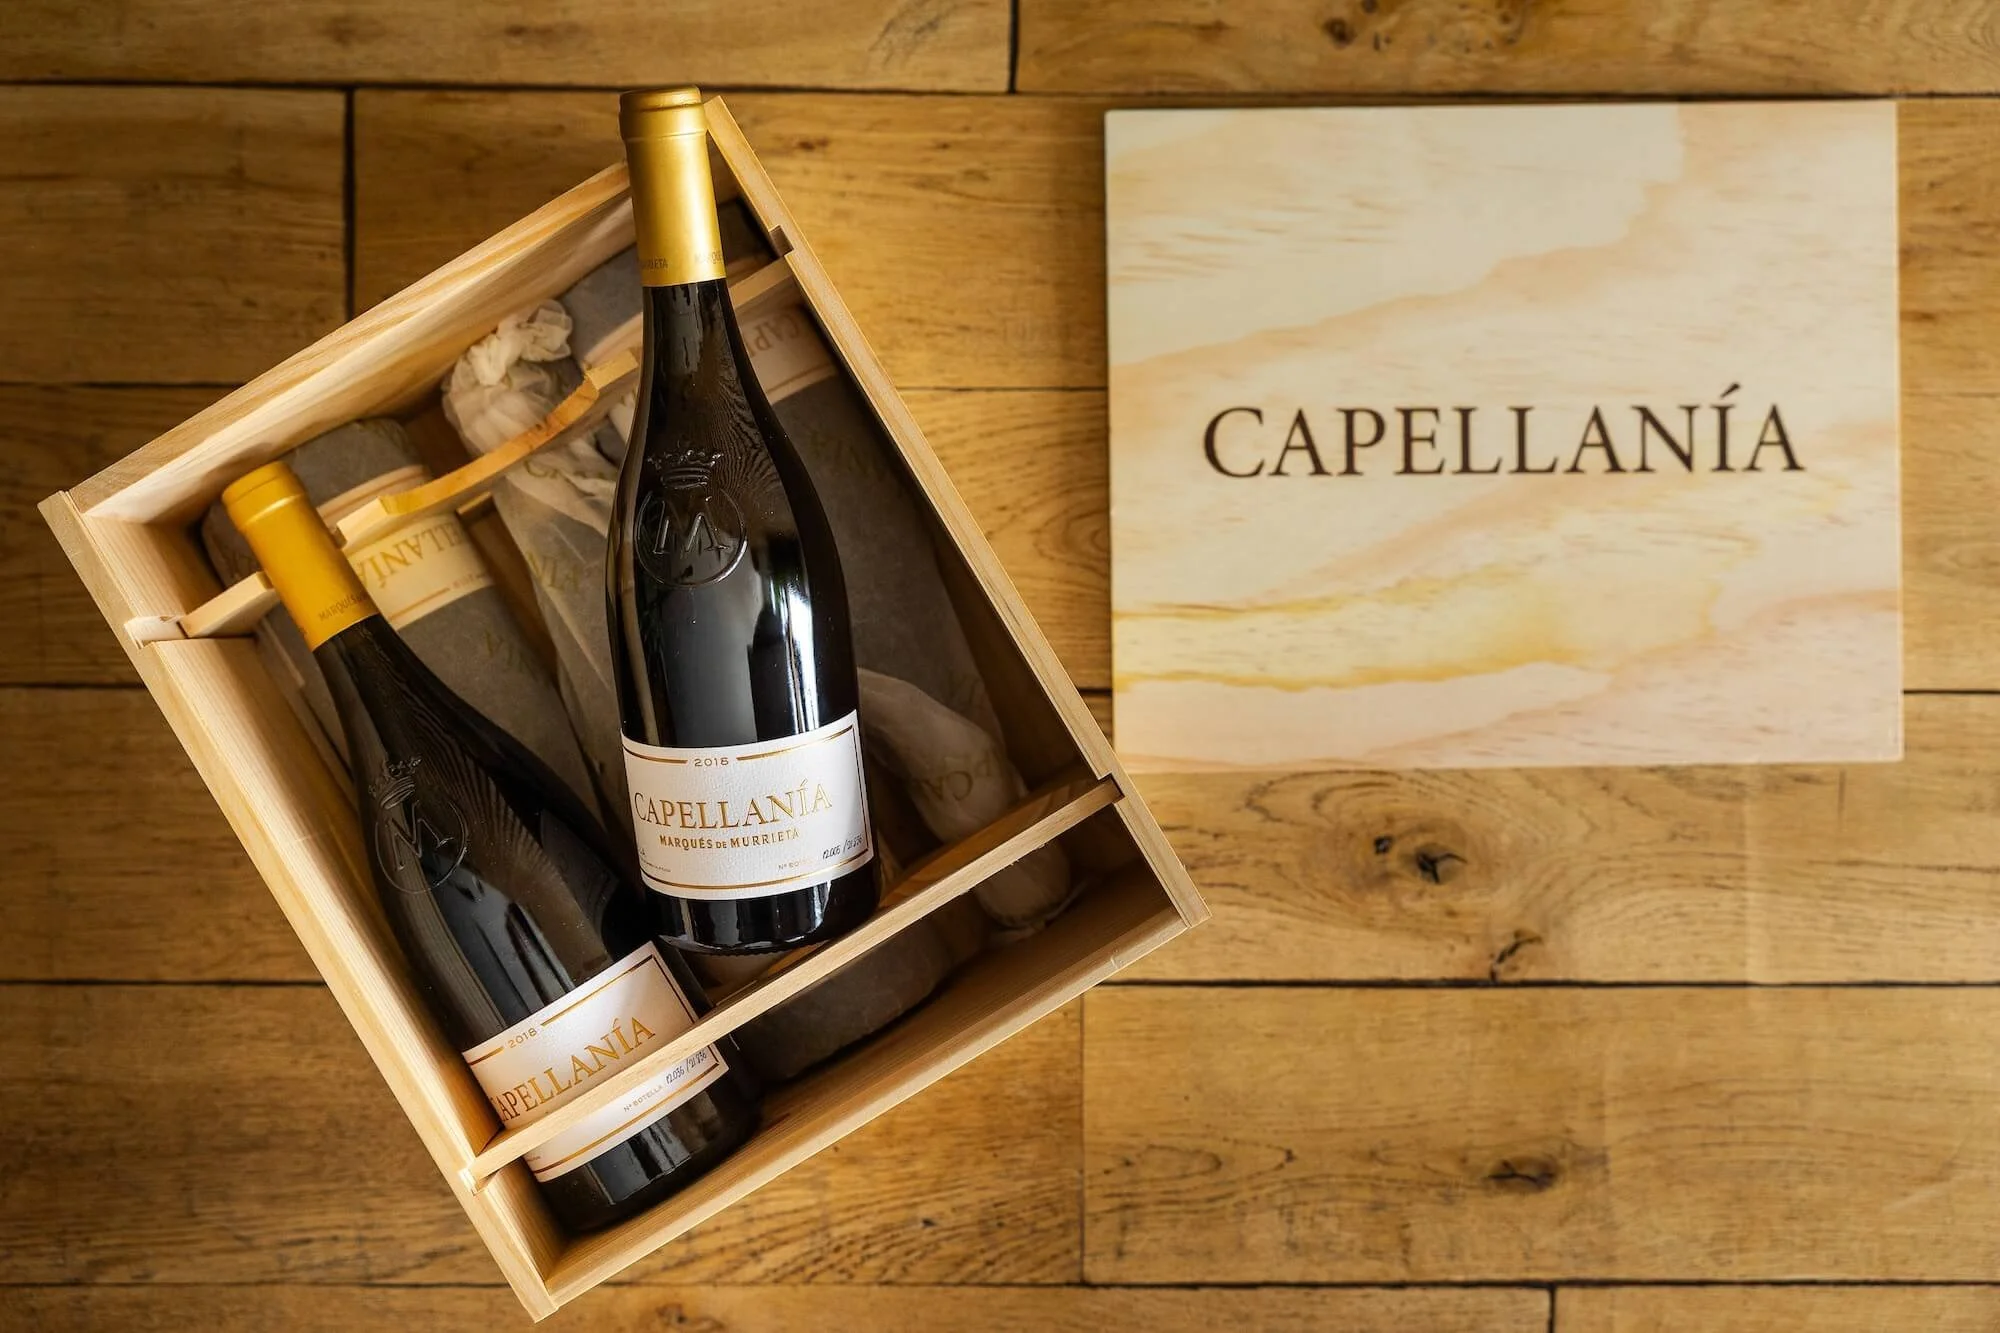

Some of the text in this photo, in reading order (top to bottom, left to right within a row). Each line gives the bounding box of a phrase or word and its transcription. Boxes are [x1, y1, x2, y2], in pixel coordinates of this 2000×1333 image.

[1203, 382, 1807, 479] CAPELLANÍA
[634, 778, 833, 830] CAPELLANÍA
[659, 835, 713, 851] MARQUÉS
[730, 828, 800, 848] MURRIETA
[508, 1027, 537, 1048] 2018
[490, 1017, 656, 1122] APELLANÍA
[633, 1085, 663, 1107] BOTELLA
